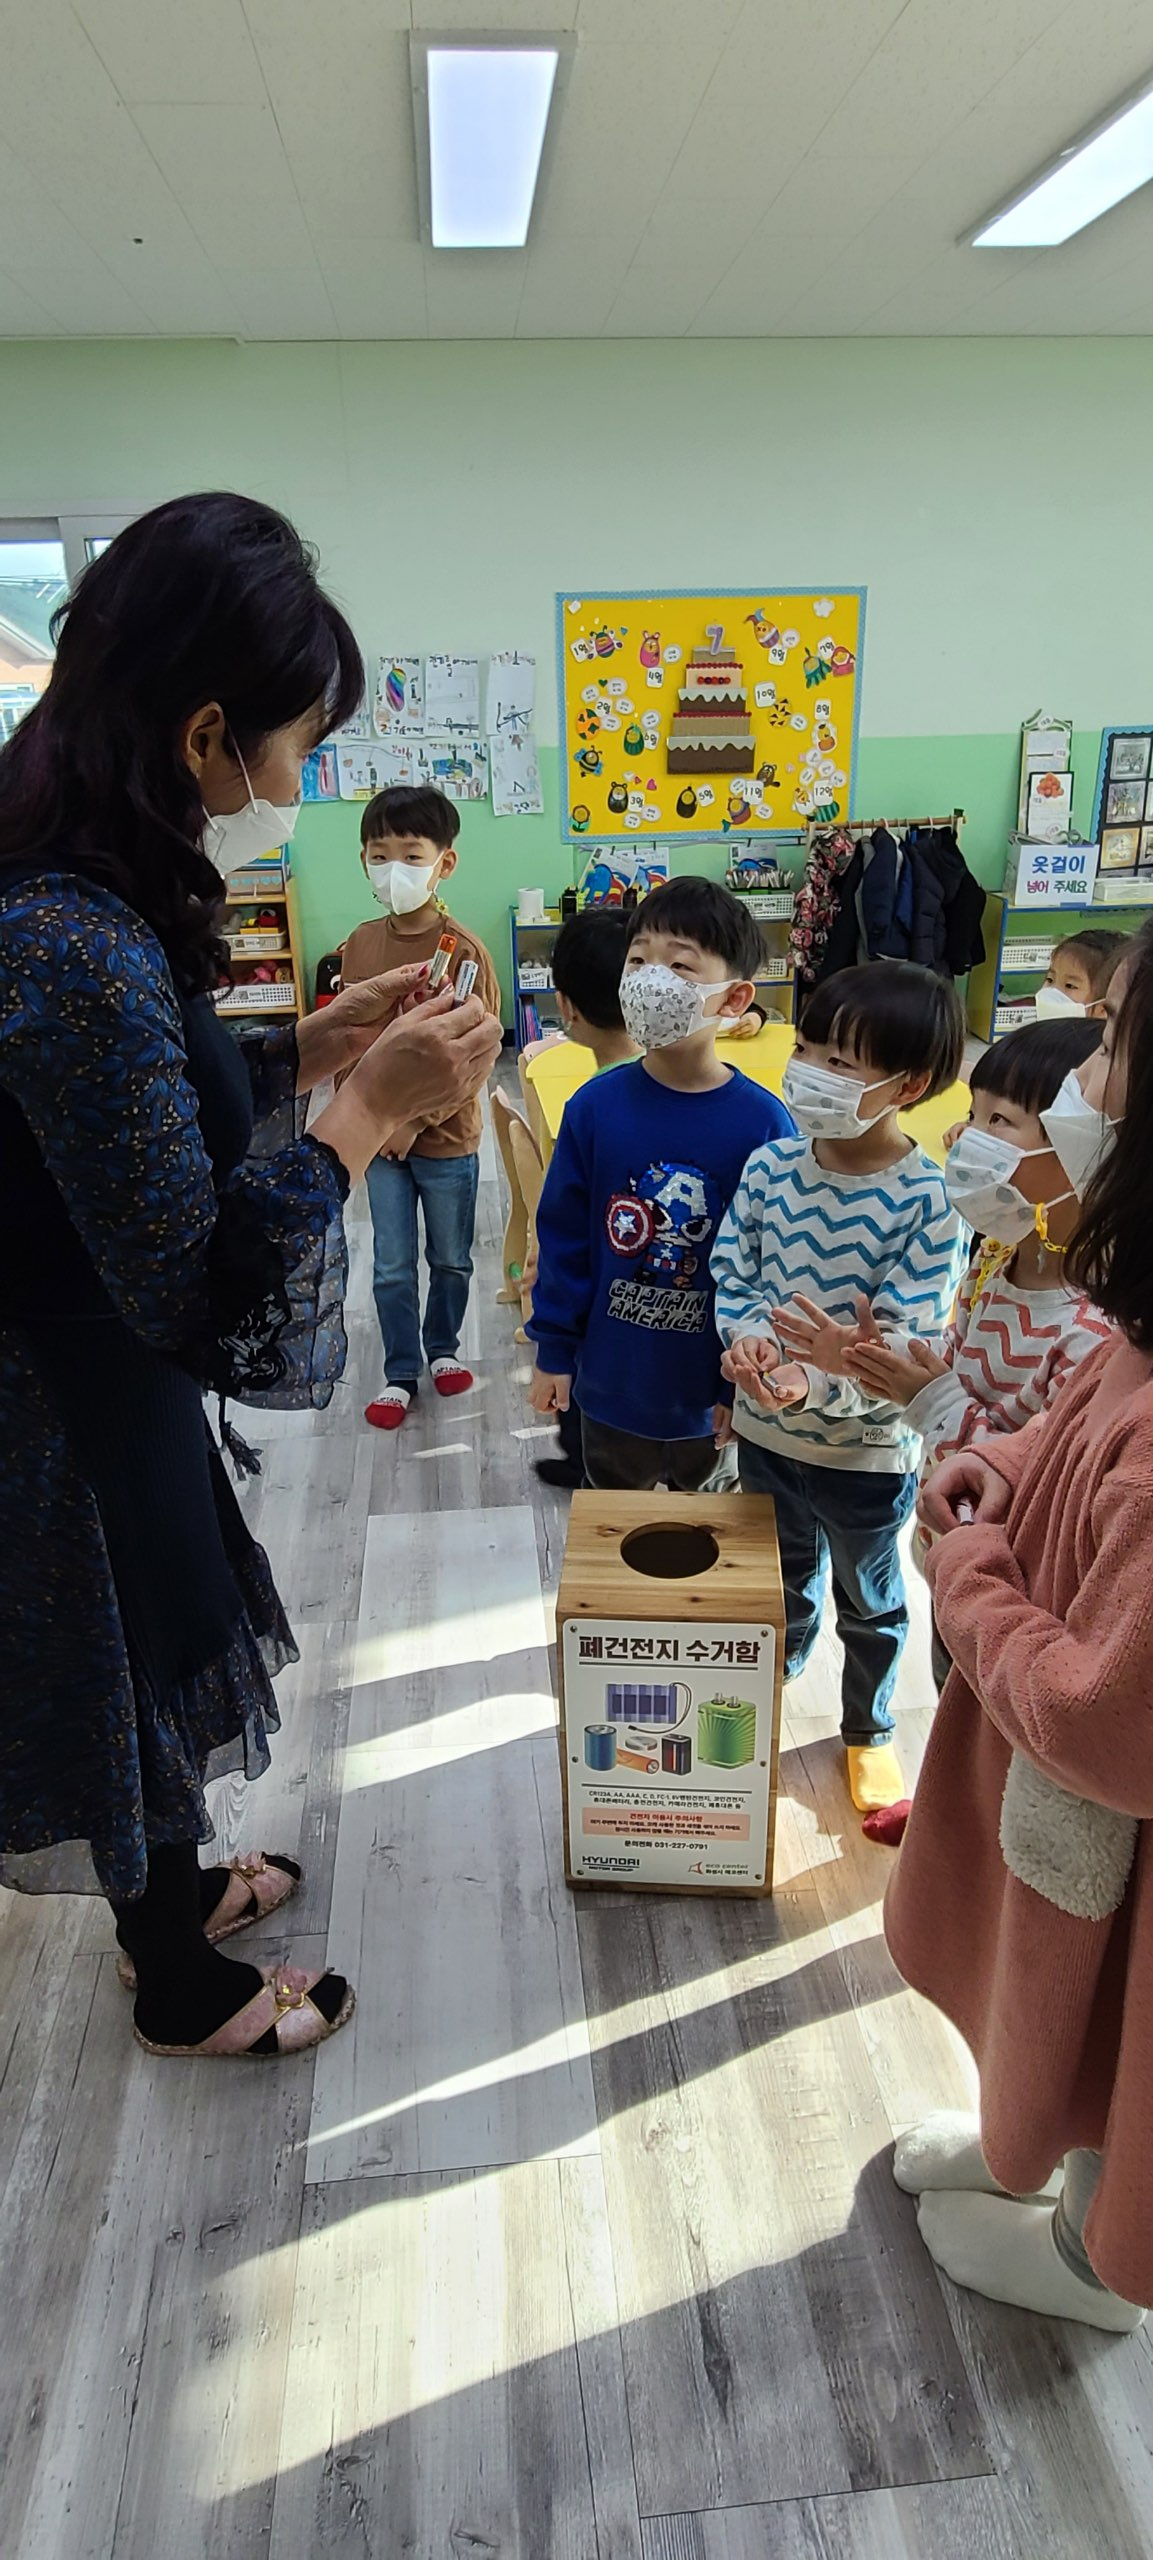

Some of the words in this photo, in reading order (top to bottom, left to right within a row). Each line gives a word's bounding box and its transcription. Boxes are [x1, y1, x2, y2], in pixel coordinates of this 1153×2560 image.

[706, 625, 725, 655] 7
[1032, 855, 1085, 874] 옷걸이
[1027, 880, 1049, 894] 넣어
[1053, 880, 1088, 893] 주세요
[609, 1279, 708, 1314] CAPTAIN
[607, 1300, 708, 1333] AMERICA
[579, 1636, 679, 1661] 폐건전지
[686, 1640, 761, 1664] 수거함
[624, 1840, 653, 1848] 문의전화
[654, 1841, 708, 1850] 031-227-0791
[582, 1855, 640, 1866] HYUNDAI
